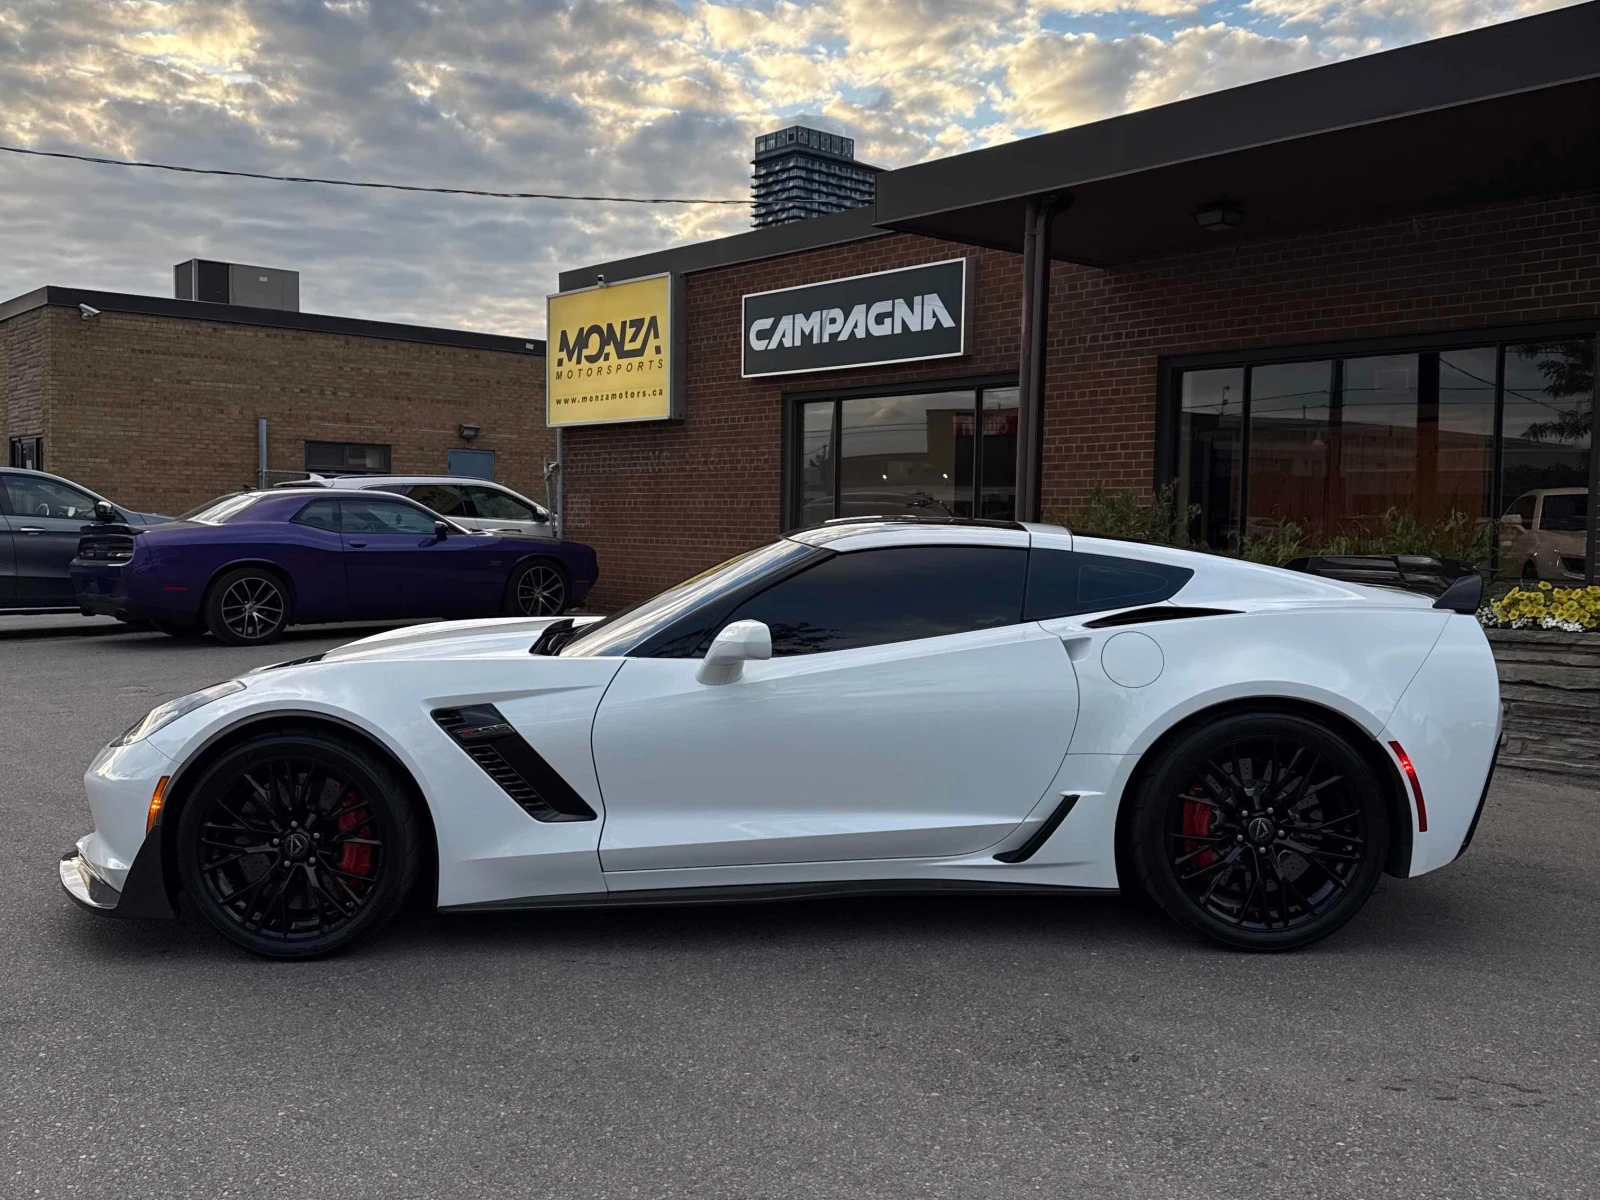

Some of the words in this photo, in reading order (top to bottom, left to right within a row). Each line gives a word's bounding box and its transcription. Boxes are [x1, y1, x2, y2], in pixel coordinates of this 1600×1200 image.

[749, 293, 956, 351] CAMPAGNA
[557, 315, 662, 367] MONZA
[556, 359, 664, 380] MOTORSPORTS
[556, 389, 664, 405] www.monzamotors.ca
